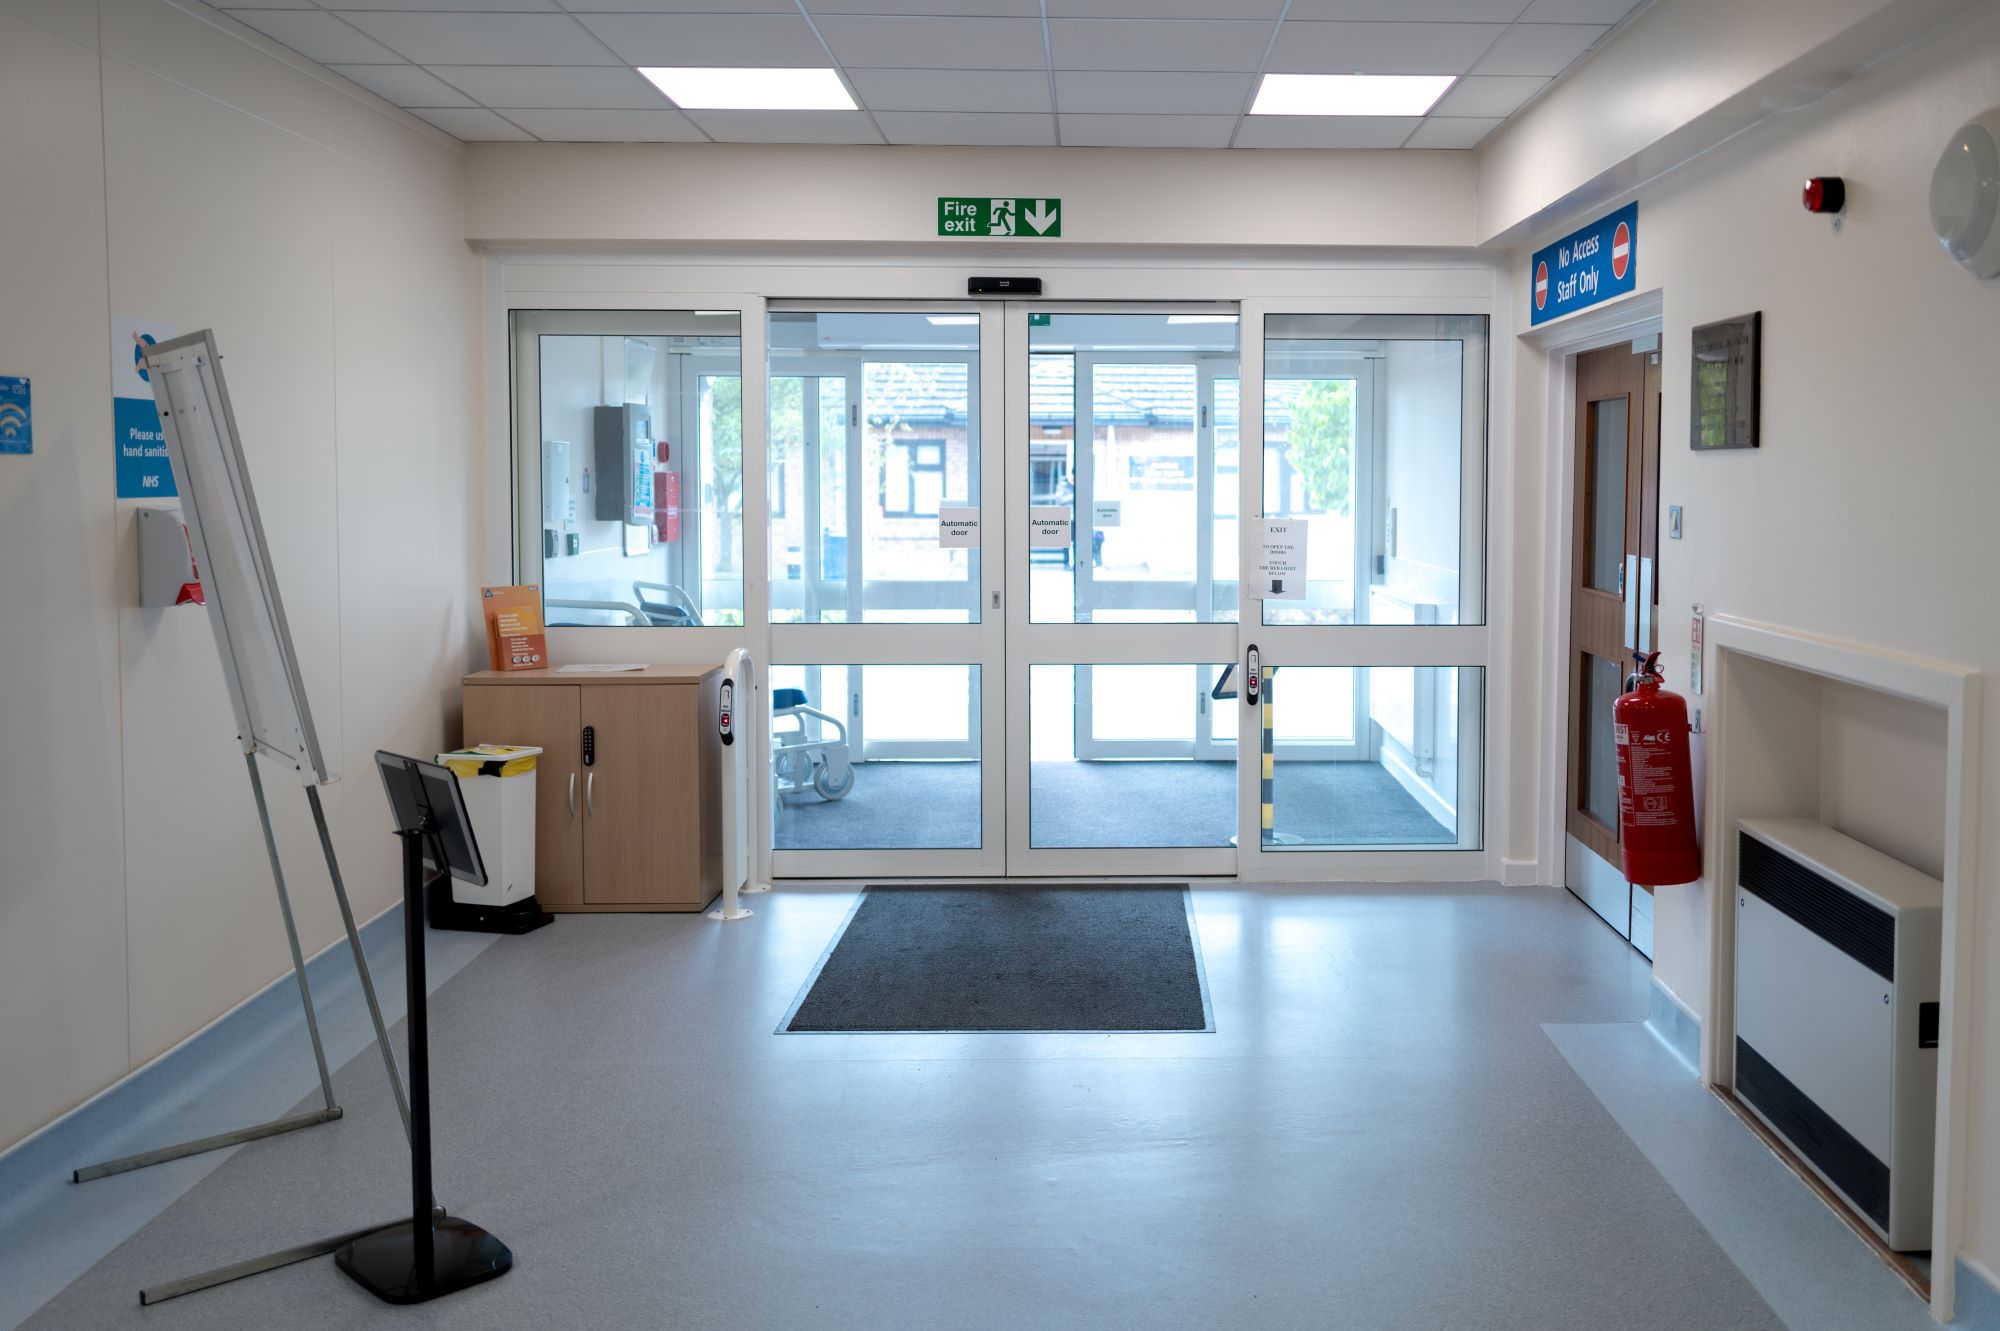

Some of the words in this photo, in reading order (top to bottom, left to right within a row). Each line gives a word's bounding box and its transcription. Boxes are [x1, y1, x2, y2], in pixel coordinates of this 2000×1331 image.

[944, 201, 977, 216] Fire
[944, 218, 976, 232] exit
[1559, 247, 1569, 269] No
[1572, 235, 1599, 263] Access
[1557, 271, 1577, 303] Staff
[1579, 265, 1599, 296] Only
[130, 427, 154, 441] Please
[156, 431, 165, 441] us
[123, 444, 143, 457] hand
[144, 445, 168, 458] sanitis
[143, 475, 159, 488] NHS
